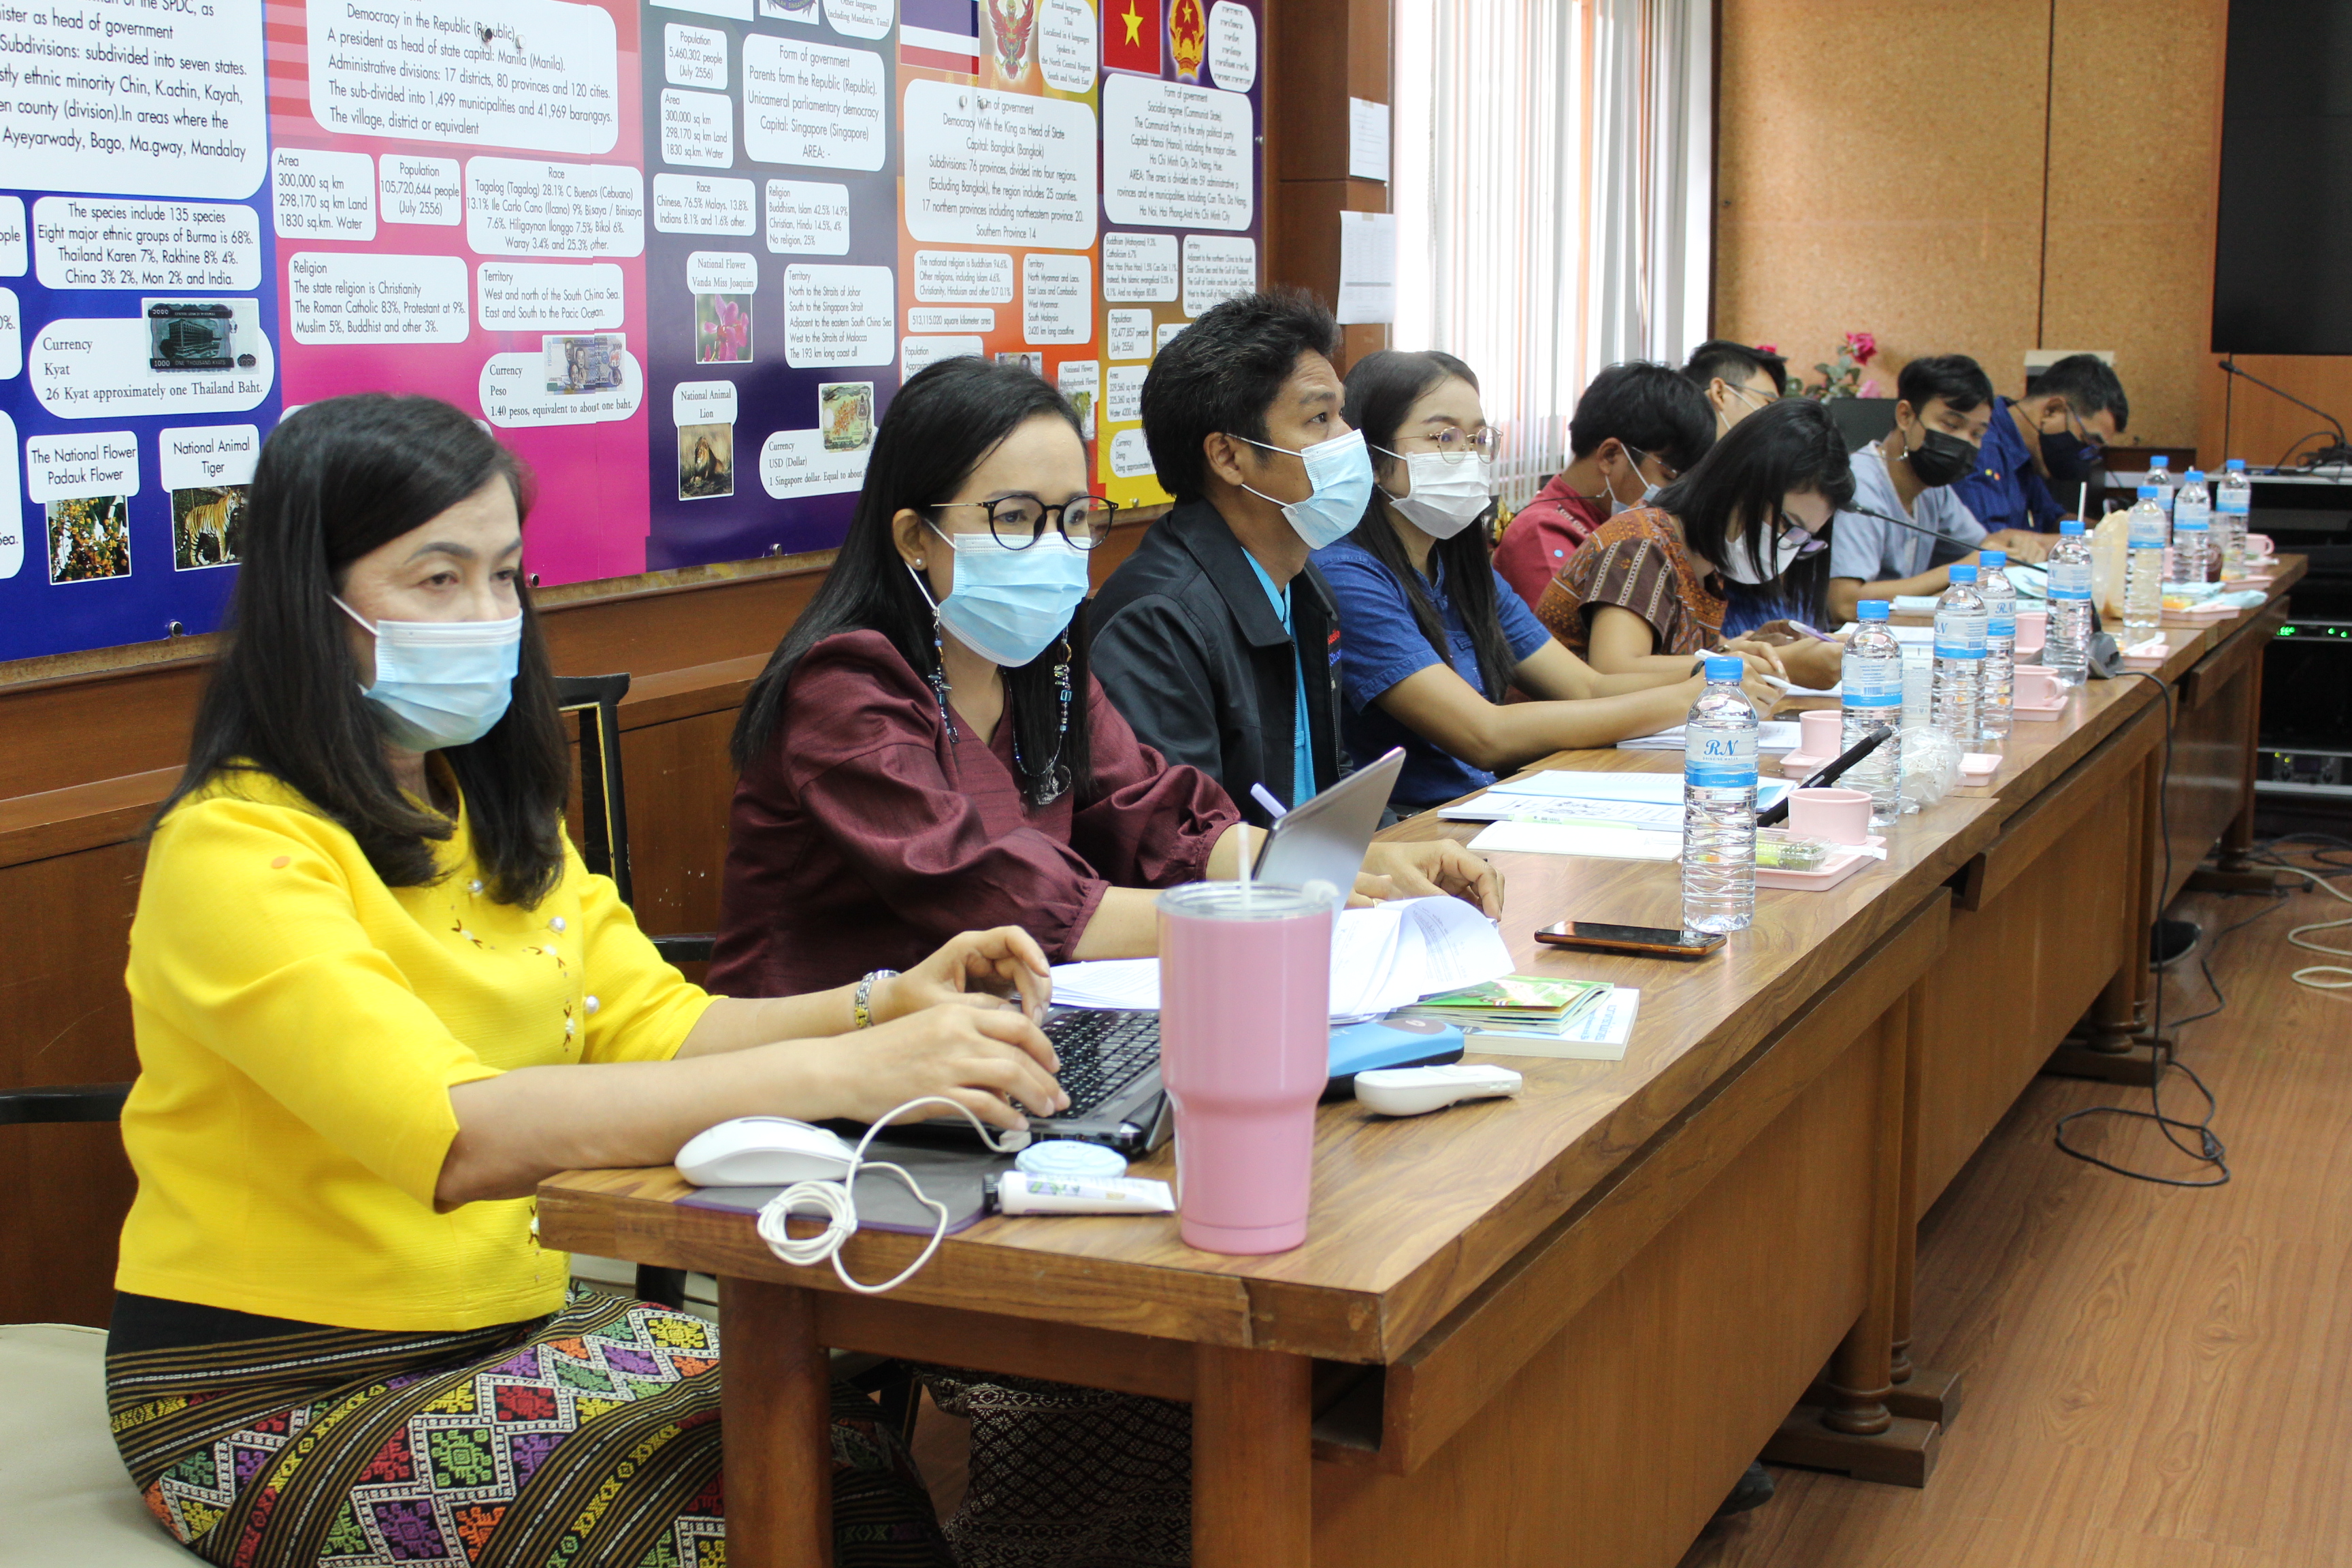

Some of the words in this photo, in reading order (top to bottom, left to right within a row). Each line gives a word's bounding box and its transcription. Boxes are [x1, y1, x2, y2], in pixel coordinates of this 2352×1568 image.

[681, 31, 710, 46] Population
[0, 33, 80, 59] Subdivisions:
[86, 42, 148, 65] subdivided
[154, 51, 175, 68] into
[180, 59, 210, 71] seven
[215, 60, 246, 75] states.
[327, 27, 336, 42] A
[340, 30, 383, 48] president
[387, 39, 397, 50] as
[402, 34, 424, 53] head
[428, 39, 437, 54] of
[440, 44, 460, 57] state
[464, 46, 494, 63] capital:
[498, 49, 526, 66] Manila
[530, 53, 565, 73] (Manila).
[780, 45, 798, 61] Form
[800, 47, 808, 61] of
[810, 54, 850, 68] government
[328, 53, 396, 76] Administrative
[399, 60, 440, 80] divisions:
[445, 67, 456, 82] 17
[460, 67, 493, 88] districts,
[497, 73, 508, 88] 80
[512, 78, 549, 93] provinces
[553, 80, 568, 95] and
[572, 83, 587, 97] 120
[590, 84, 610, 99] cities.
[750, 65, 776, 82] Parents
[779, 67, 795, 84] form
[798, 70, 808, 86] the
[811, 74, 840, 92] Republic
[843, 78, 877, 97] (Republic).
[665, 93, 680, 105] Area
[749, 90, 789, 108] Unicameral
[792, 95, 840, 118] parliamentary
[843, 99, 879, 122] democracy
[760, 115, 788, 134] Capital:
[791, 118, 827, 138] Singapore
[830, 122, 868, 142] (Singapore)
[943, 113, 976, 133] Democracy
[977, 116, 992, 130] With
[994, 118, 1002, 132] the
[1004, 121, 1017, 137] King
[1019, 127, 1026, 135] as
[1028, 124, 1043, 137] Head
[1044, 125, 1050, 137] of
[1051, 127, 1064, 140] State
[3, 126, 85, 152] Ayeyarwady,
[91, 132, 125, 154] Bago,
[130, 135, 186, 158] Ma.gway,
[191, 139, 246, 162] Mandalay
[666, 144, 682, 155] 1830
[685, 144, 702, 159] sq.km.
[705, 147, 723, 159] Water
[991, 140, 1015, 157] Bangkok
[1017, 143, 1044, 160] (Bangkok)
[278, 153, 299, 167] Area
[400, 162, 439, 179] Population
[969, 159, 977, 172] 76
[1009, 162, 1030, 177] divided
[1032, 166, 1042, 178] into
[1044, 165, 1055, 179] four
[278, 173, 316, 188] 300,000
[319, 180, 329, 193] sq
[332, 175, 344, 189] km
[381, 180, 431, 195] 105,720,644
[434, 183, 459, 200] people
[68, 201, 87, 218] The
[91, 206, 127, 222] species
[131, 205, 165, 220] include
[170, 208, 189, 221] 135
[193, 210, 225, 225] species
[399, 199, 416, 217] (July
[419, 201, 442, 216] 2556)
[976, 223, 1001, 237] Southern
[1003, 226, 1026, 239] Province
[1029, 227, 1036, 239] 14
[58, 246, 103, 262] Thailand
[107, 248, 136, 262] Karen
[140, 249, 158, 264] 7%,
[163, 248, 200, 263] Rakhine
[204, 250, 218, 264] 8%
[222, 251, 238, 264] 4%.
[698, 258, 723, 268] National
[726, 258, 746, 269] Flower
[294, 259, 327, 277] Religion
[1028, 259, 1044, 270] Territory
[692, 276, 711, 287] Vanda
[713, 277, 728, 287] Miss
[730, 278, 753, 291] Joaquim
[789, 270, 811, 284] Territory
[295, 299, 310, 313] The
[314, 301, 342, 313] Roman
[346, 299, 378, 313] Catholic
[382, 301, 400, 314] 83%,
[404, 301, 440, 314] Protestant
[443, 304, 450, 314] at
[453, 301, 466, 314] 9%.
[913, 315, 943, 325] 513,115.020
[944, 318, 958, 327] square
[960, 314, 979, 325] kilometer
[43, 338, 93, 354] Currency
[905, 345, 929, 358] Population
[44, 363, 70, 379] Kyat
[490, 364, 523, 378] Currency
[46, 388, 59, 400] 26
[64, 387, 89, 404] Kyat
[93, 383, 166, 402] approximately
[169, 387, 187, 395] one
[191, 380, 234, 395] Thailand
[238, 380, 263, 393] Baht.
[490, 385, 506, 395] Peso
[681, 389, 707, 401] National
[709, 388, 731, 399] Animal
[491, 406, 506, 416] 1.40
[509, 408, 529, 419] pesos,
[533, 402, 568, 418] equivalent
[570, 405, 577, 413] to
[580, 402, 600, 412] about
[617, 398, 632, 409] baht.
[700, 408, 713, 418] Lion
[31, 448, 50, 463] The
[54, 444, 99, 462] National
[103, 444, 136, 459] Flower
[174, 438, 214, 455] National
[218, 436, 250, 452] Animal
[769, 441, 794, 453] Currency
[201, 461, 225, 477] Tiger
[769, 458, 783, 468] USD
[785, 456, 807, 468] (Dollar)
[48, 468, 86, 485] Padauk
[91, 466, 123, 481] Flower
[1703, 739, 1739, 755] RN
